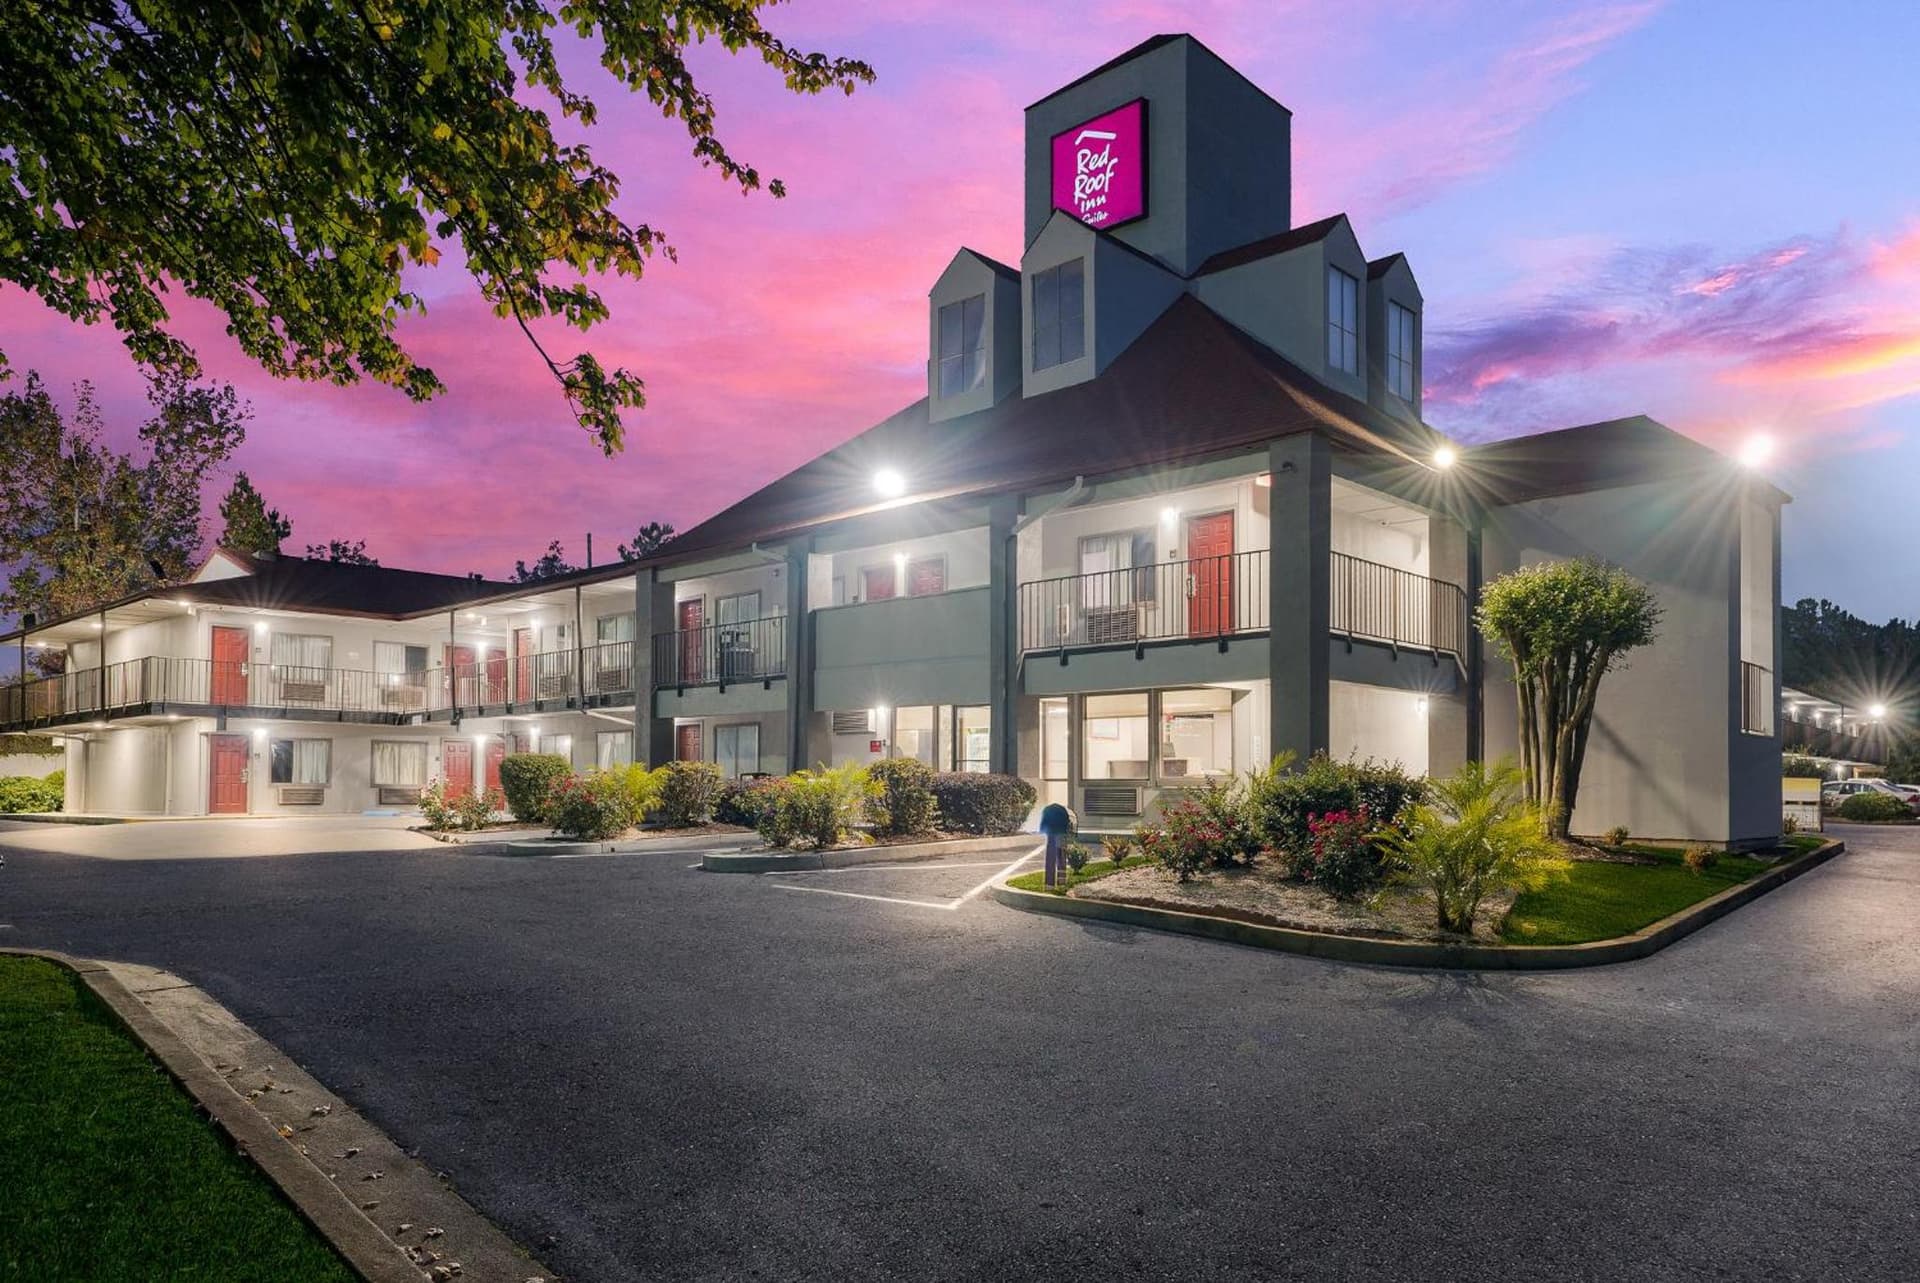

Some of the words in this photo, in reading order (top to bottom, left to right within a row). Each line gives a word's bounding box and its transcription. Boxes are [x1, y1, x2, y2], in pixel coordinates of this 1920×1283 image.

[1077, 143, 1111, 174] Red
[1074, 157, 1119, 205] Roof
[1081, 194, 1107, 213] Inn
